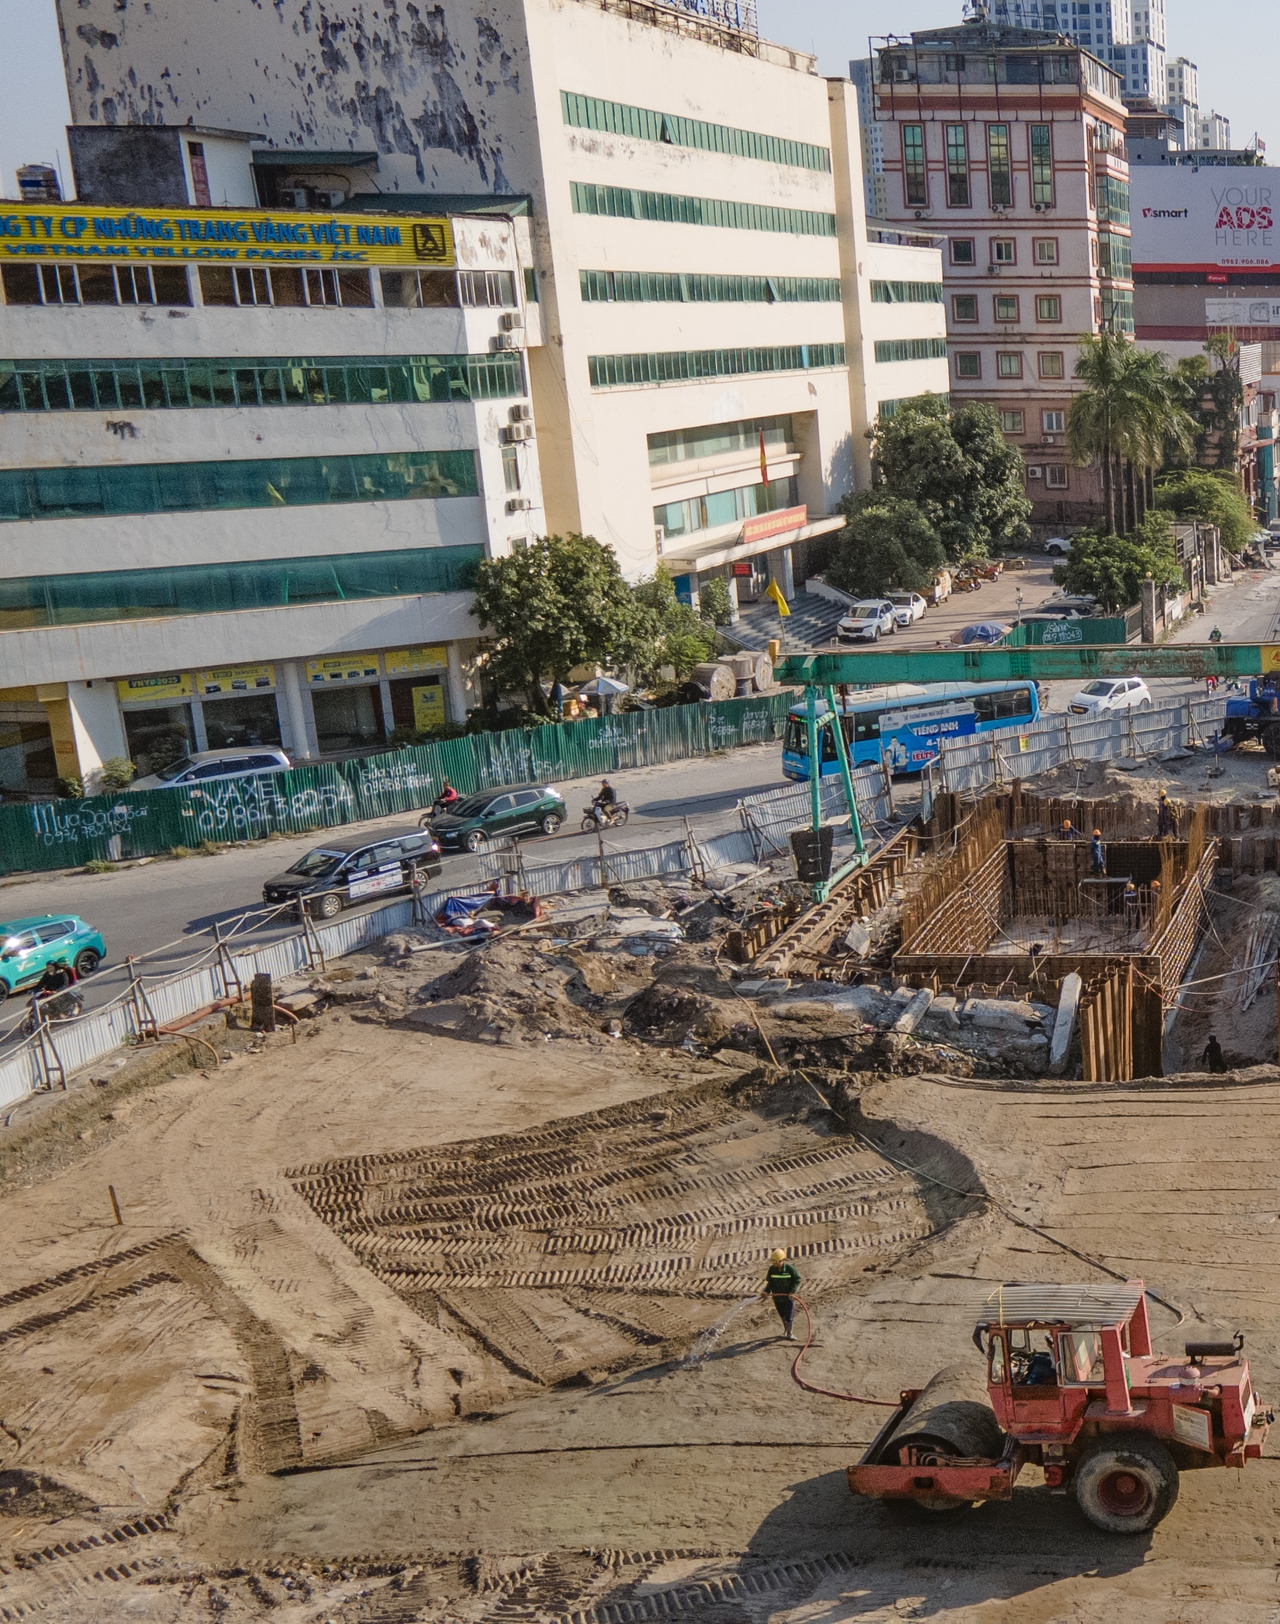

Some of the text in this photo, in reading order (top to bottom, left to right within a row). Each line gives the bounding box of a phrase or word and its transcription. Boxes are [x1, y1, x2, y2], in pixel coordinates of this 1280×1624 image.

[1210, 187, 1272, 215] YOUR
[1215, 206, 1273, 229] ADS
[25, 215, 53, 237] TY
[60, 216, 88, 238] CP
[93, 212, 173, 240] NHỮNG
[175, 218, 248, 242] TRANG
[251, 217, 308, 244] VÀNG
[309, 219, 354, 249] VIỆT
[357, 225, 402, 246] NAM
[1215, 230, 1273, 246] HERE
[4, 244, 130, 256] VIETNAM
[135, 246, 238, 258] YELLOW
[246, 248, 322, 260] PAGES
[940, 721, 959, 733] ANH
[912, 751, 936, 761] IELTS
[32, 803, 80, 834] Mua
